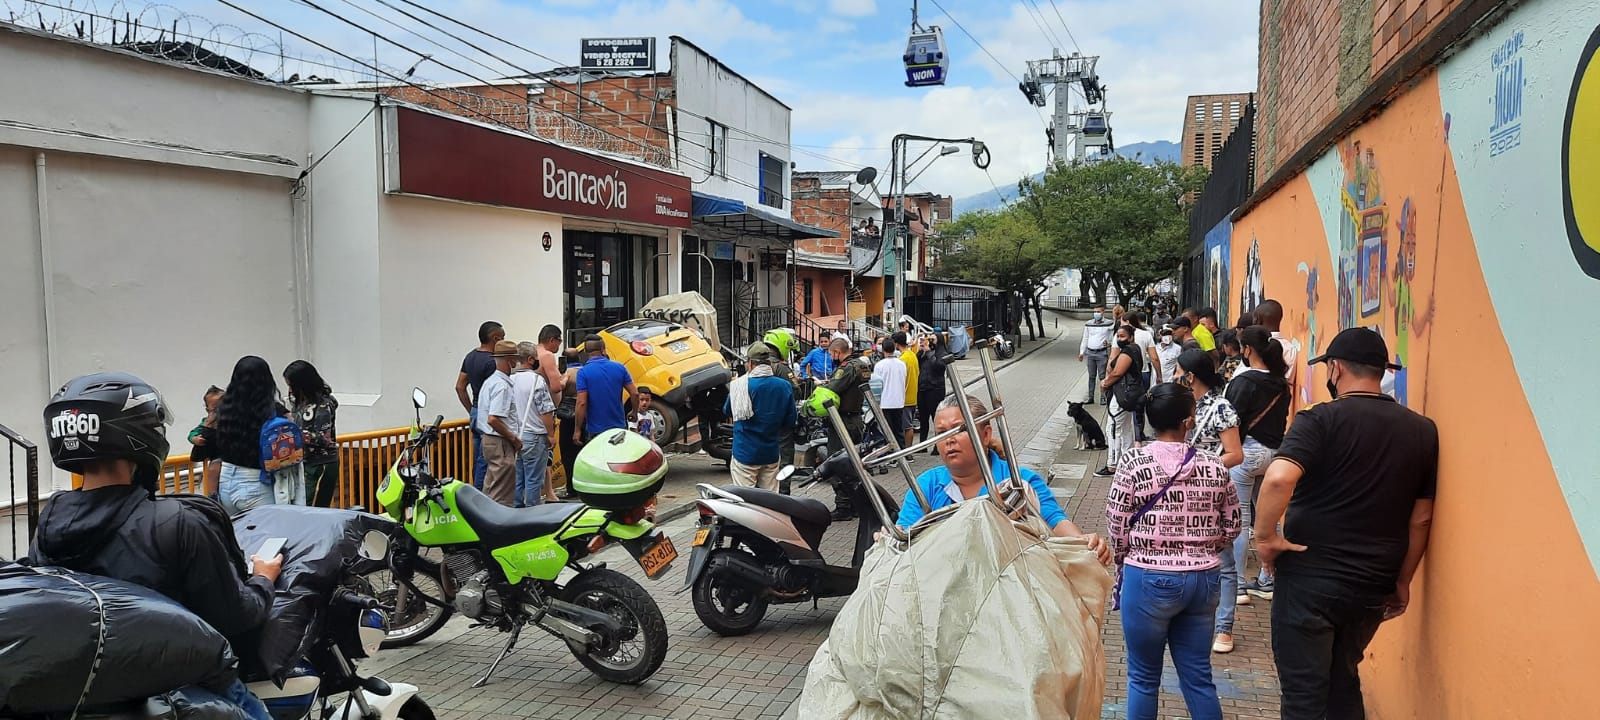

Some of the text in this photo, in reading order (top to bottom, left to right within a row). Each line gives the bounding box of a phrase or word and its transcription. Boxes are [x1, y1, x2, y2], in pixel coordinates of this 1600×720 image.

[912, 69, 935, 80] WOM
[51, 413, 100, 438] JIT86D
[1122, 449, 1145, 464] OVE
[1108, 488, 1131, 504] OVE
[1161, 490, 1185, 503] AND
[434, 514, 458, 524] ICIA
[1187, 515, 1212, 528] LOVE
